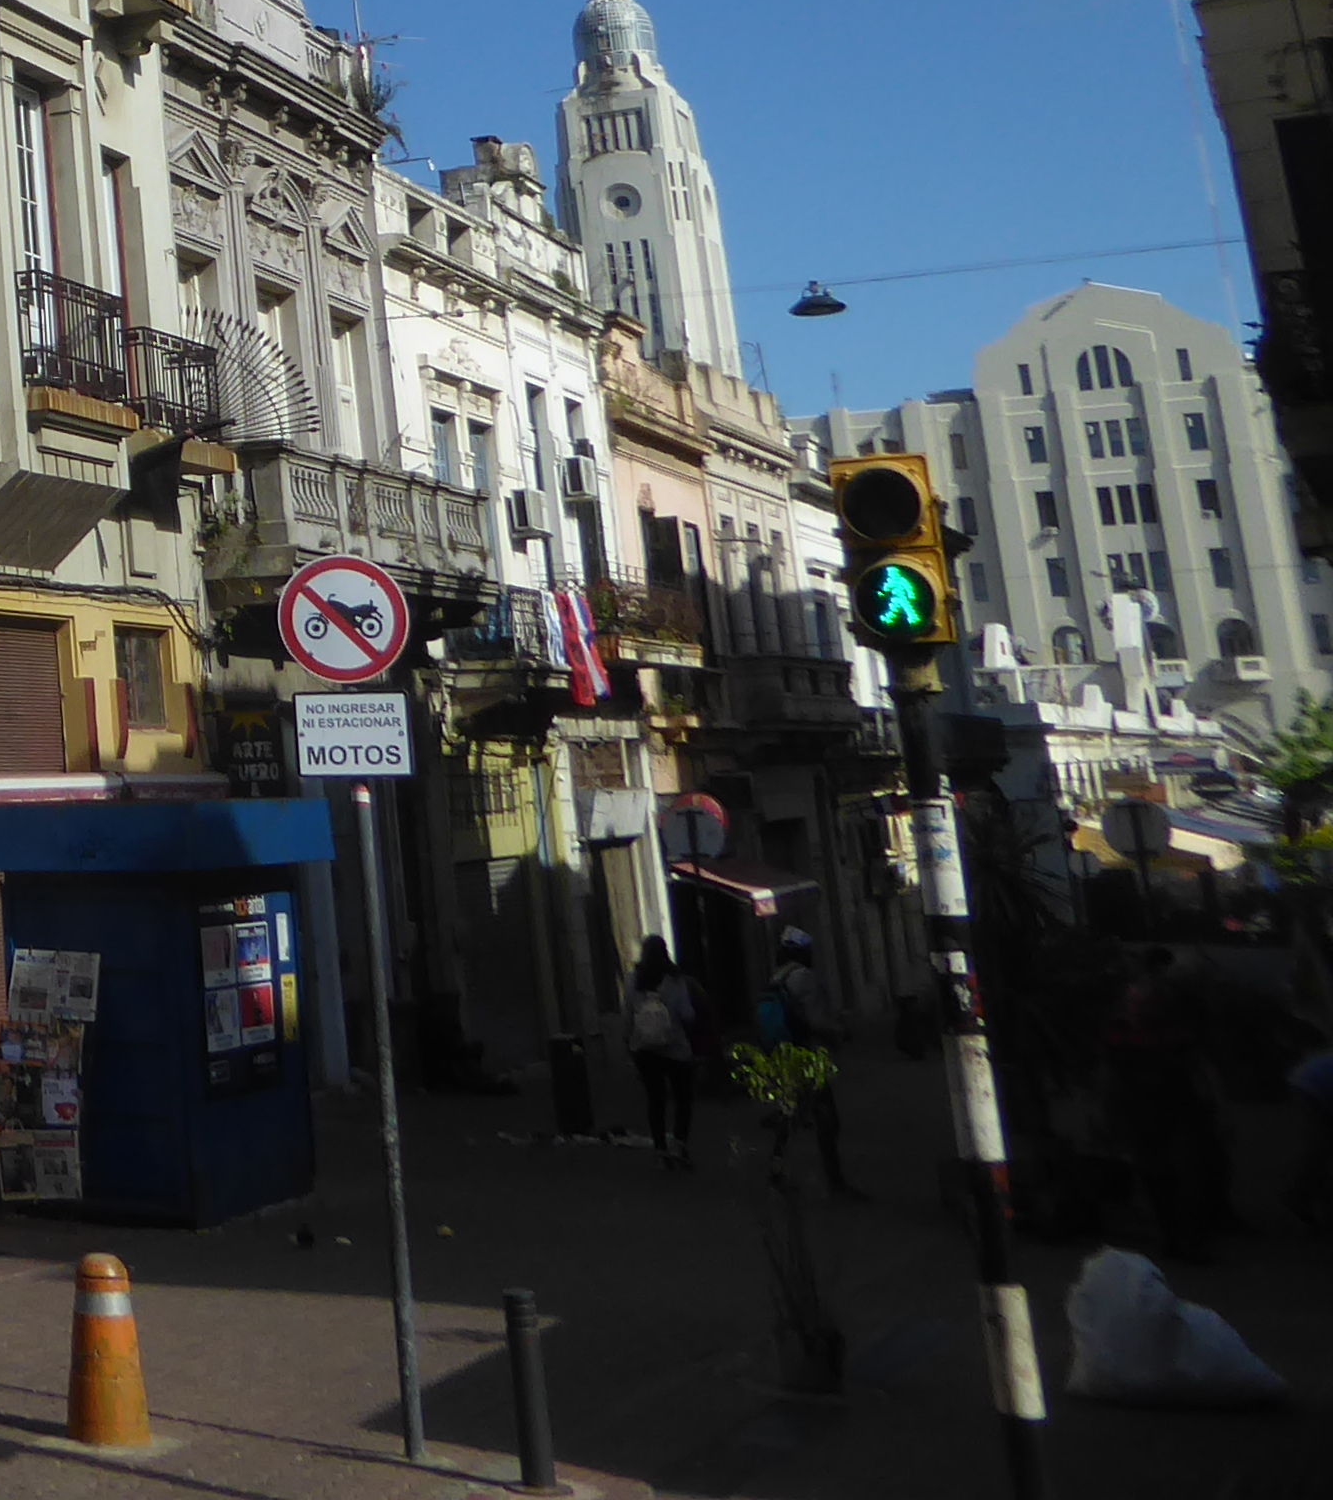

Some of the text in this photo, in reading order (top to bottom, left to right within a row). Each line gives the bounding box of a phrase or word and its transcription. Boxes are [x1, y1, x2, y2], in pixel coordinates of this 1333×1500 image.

[305, 702, 395, 714] NO INGRESAR
[302, 716, 402, 729] NI ESTACIONAR
[233, 740, 274, 759] ARTE
[306, 744, 402, 766] MOTOS
